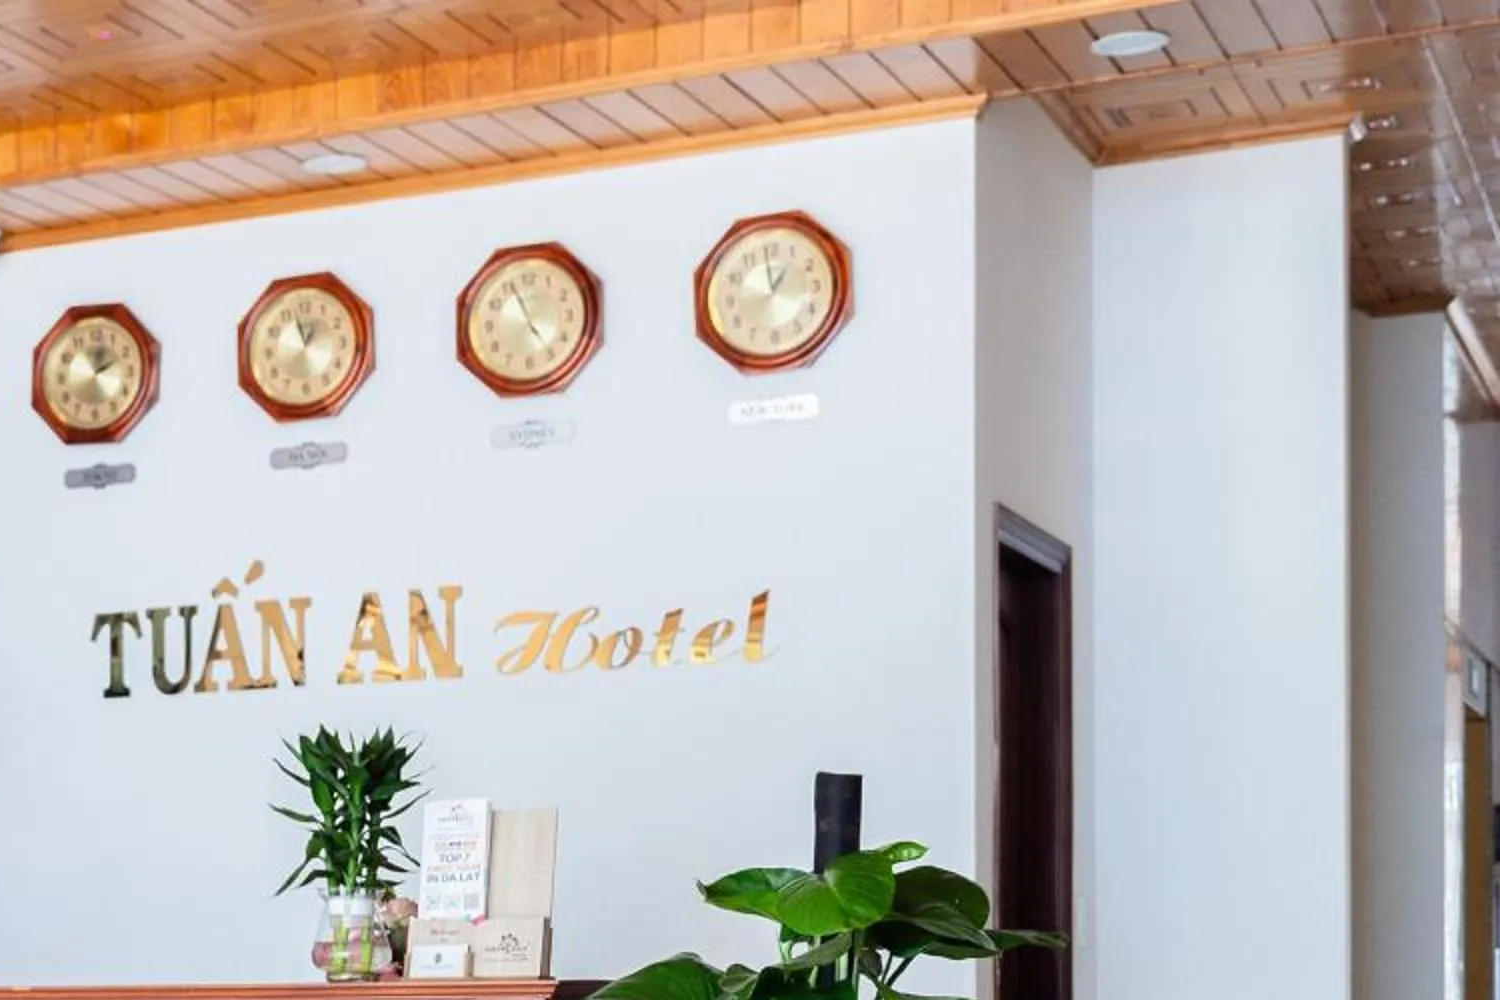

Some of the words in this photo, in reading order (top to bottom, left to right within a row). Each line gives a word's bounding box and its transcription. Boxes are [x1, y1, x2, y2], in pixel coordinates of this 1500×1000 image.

[91, 559, 312, 698] TUẤN
[336, 585, 465, 685] AN
[494, 588, 781, 677] Hotel
